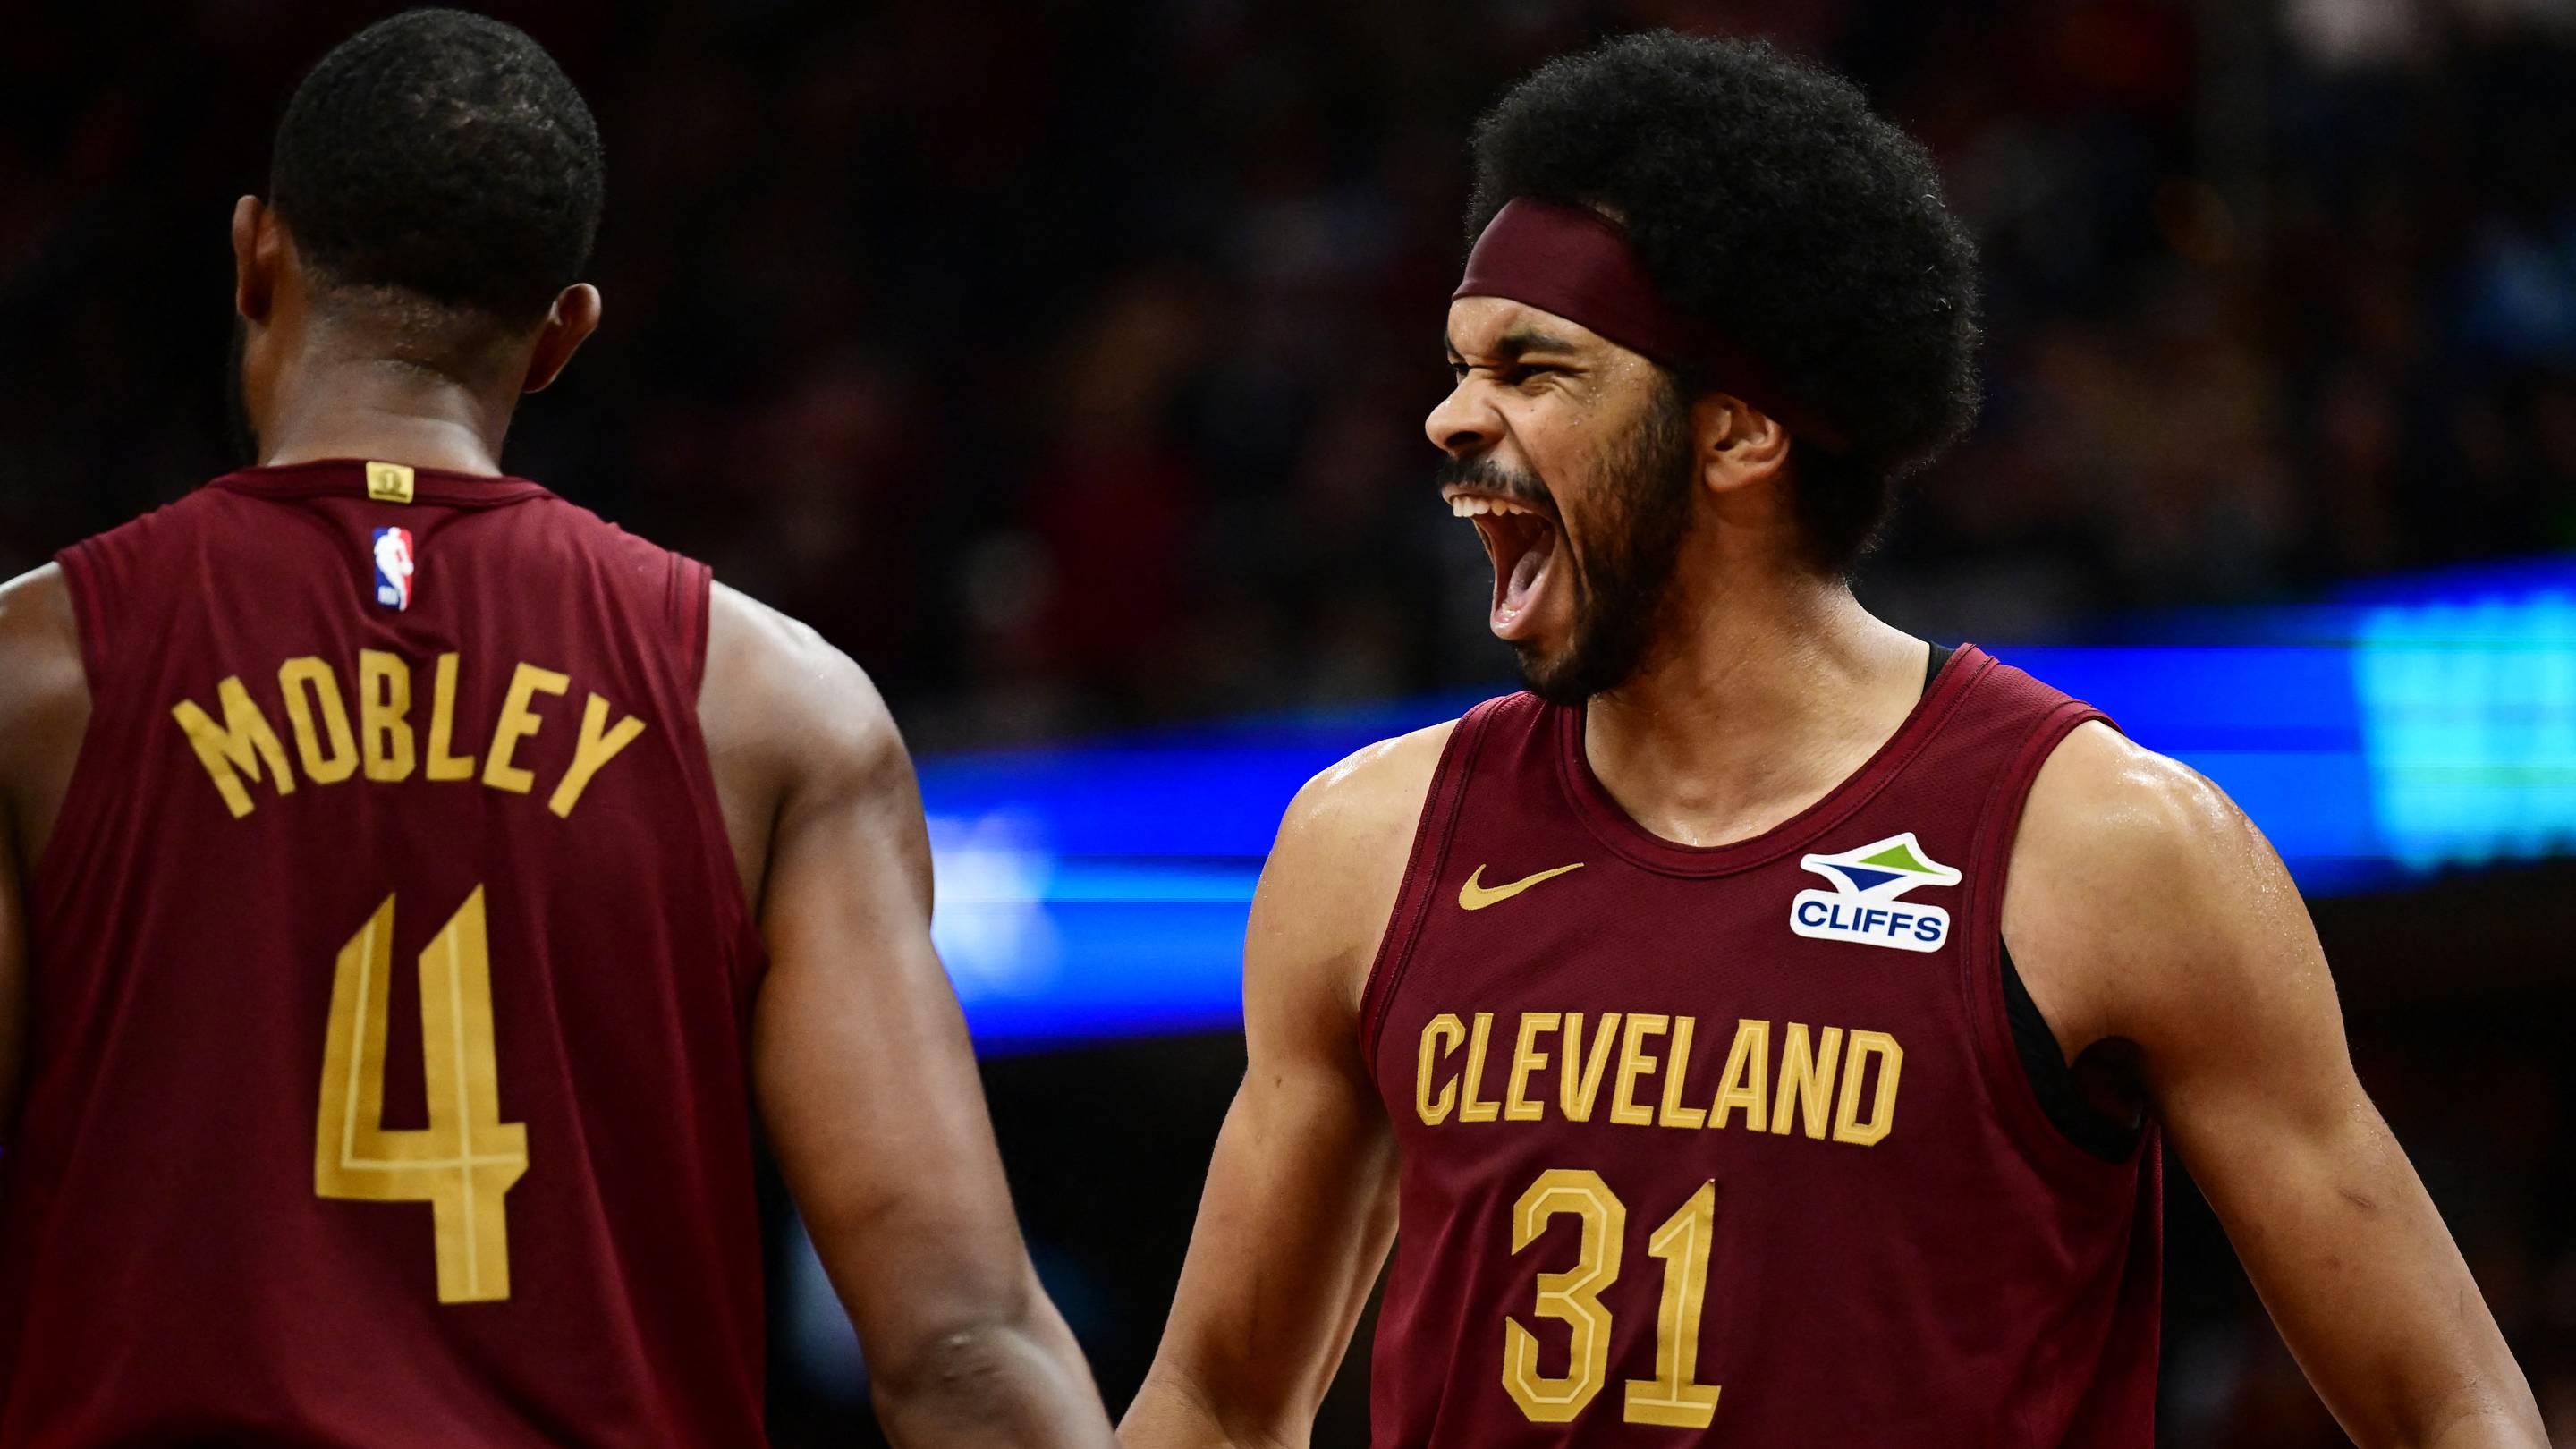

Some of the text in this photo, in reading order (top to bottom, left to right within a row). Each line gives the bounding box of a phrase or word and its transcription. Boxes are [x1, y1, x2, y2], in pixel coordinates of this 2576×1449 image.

[171, 648, 646, 819] MOBLEY
[1798, 901, 1942, 942] CLIFFS
[315, 883, 530, 1305] 4
[1416, 1012, 1904, 1147] CLEVELAND
[1501, 1169, 1722, 1428] 31
